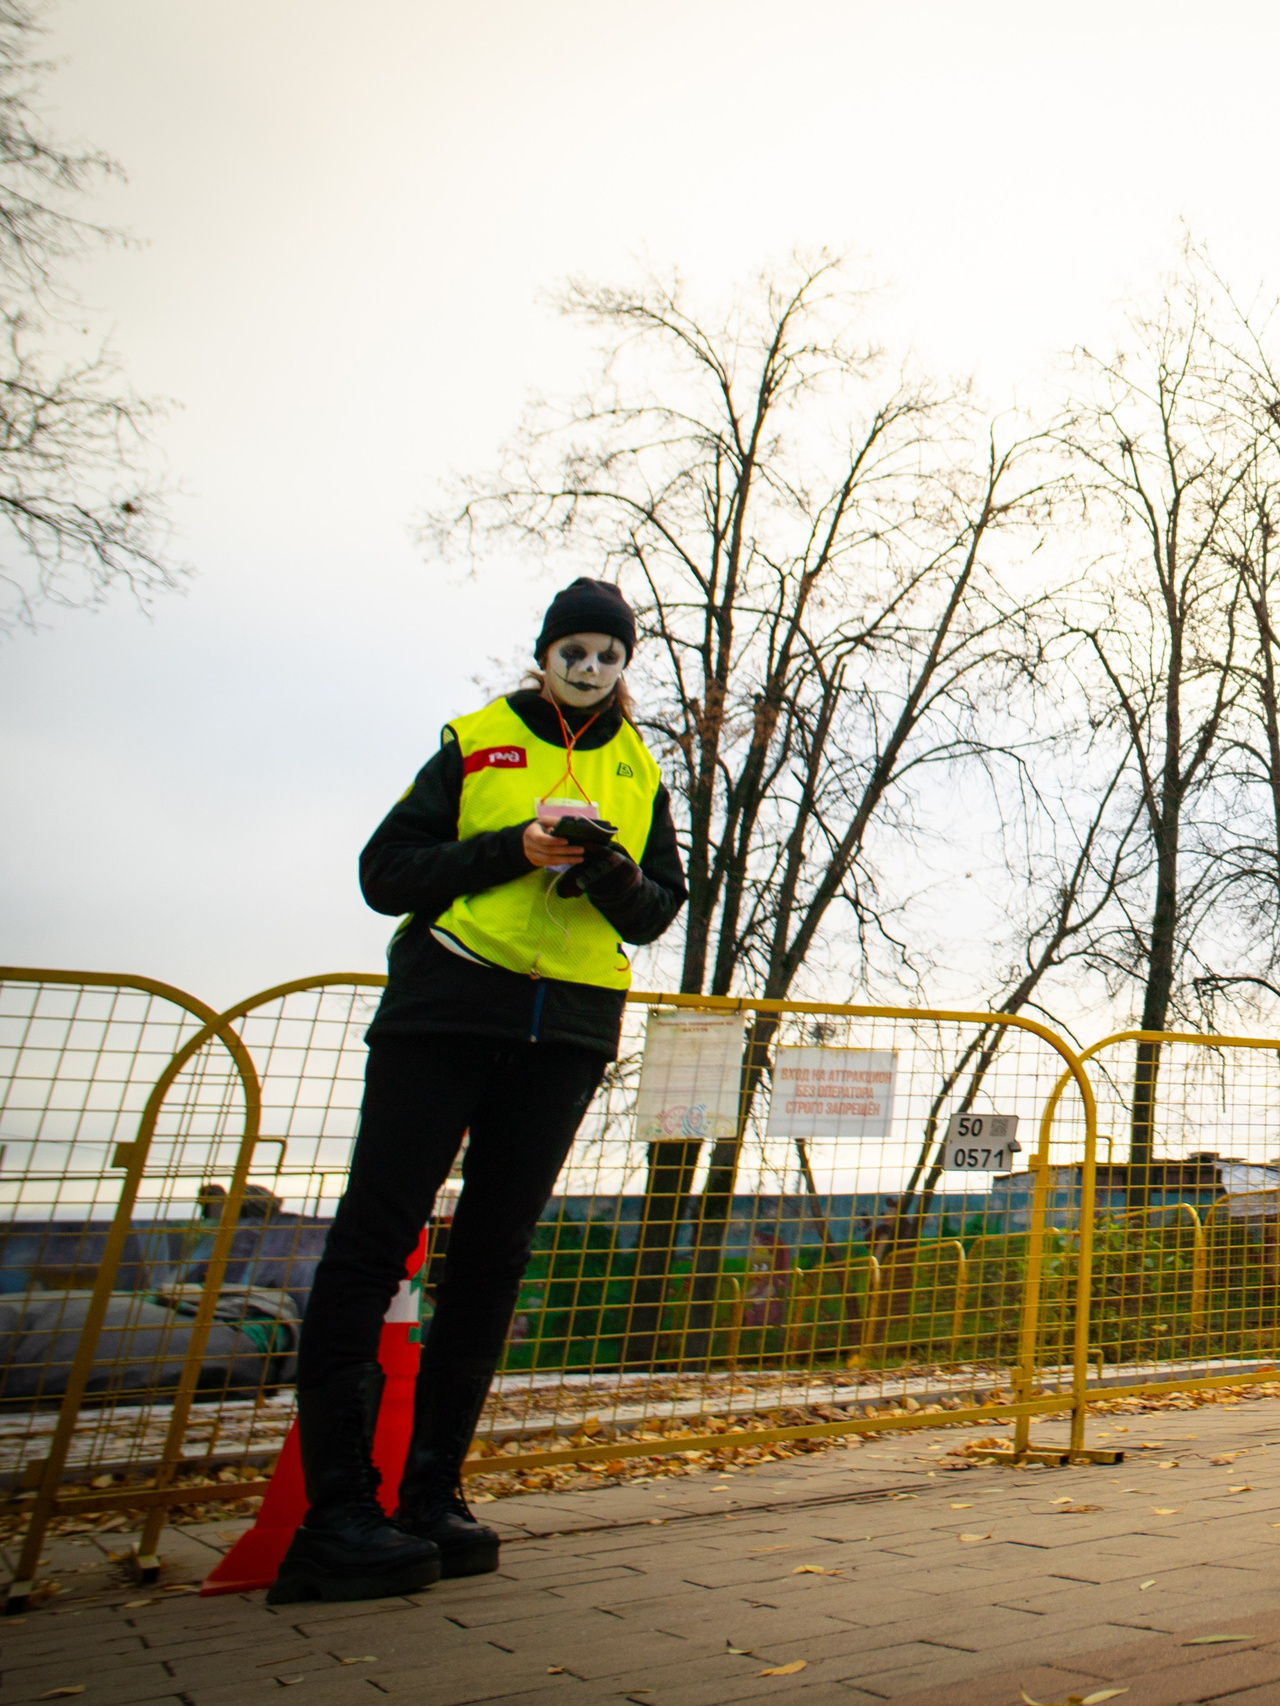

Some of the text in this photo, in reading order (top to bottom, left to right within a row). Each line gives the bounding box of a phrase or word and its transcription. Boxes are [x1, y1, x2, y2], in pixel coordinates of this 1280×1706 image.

[780, 1067, 892, 1084] ВХОД НА АТТРАКЦИОН
[795, 1084, 874, 1099] БЕЗ ОПЕРАТОРА
[785, 1101, 824, 1115] СТРОГО
[958, 1118, 983, 1137] 50
[954, 1148, 1004, 1168] 0571
